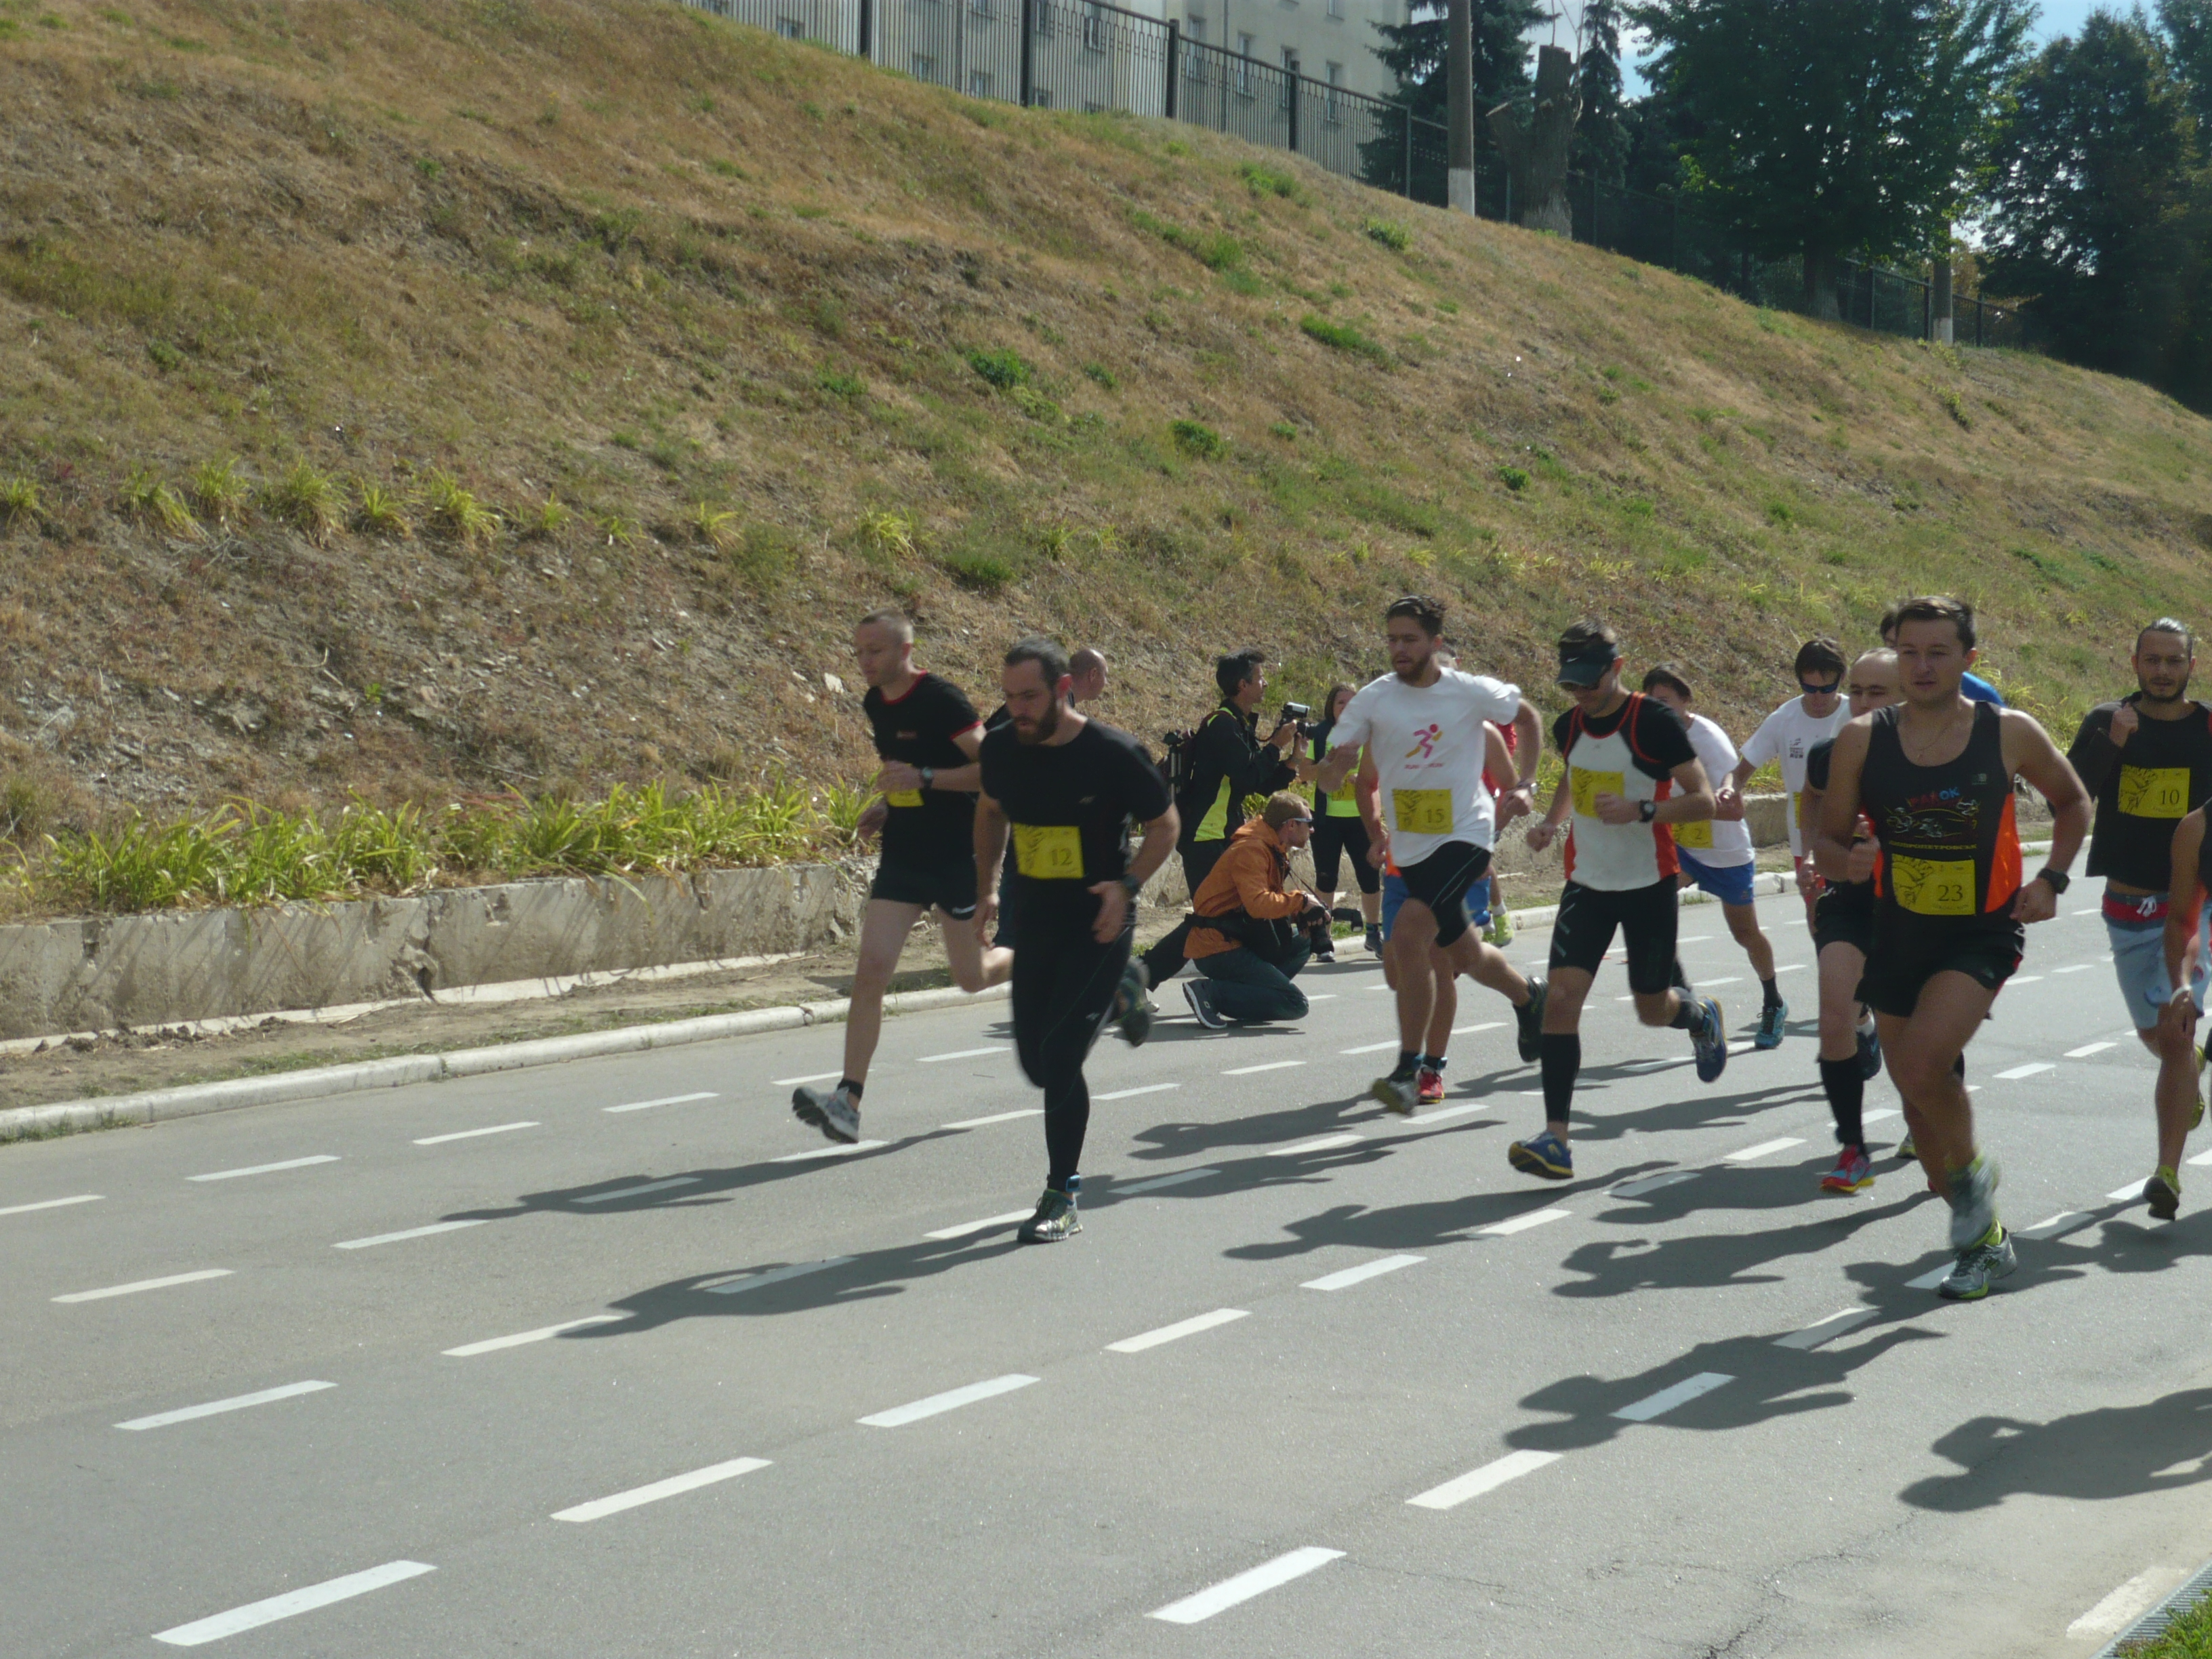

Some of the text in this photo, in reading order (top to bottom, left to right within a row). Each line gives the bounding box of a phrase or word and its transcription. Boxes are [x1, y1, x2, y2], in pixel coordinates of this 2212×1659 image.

[2161, 789, 2180, 805] 10
[1427, 808, 1445, 823] 15
[1694, 827, 1703, 840] 2
[1050, 847, 1073, 866] 12
[1937, 884, 1964, 902] 23
